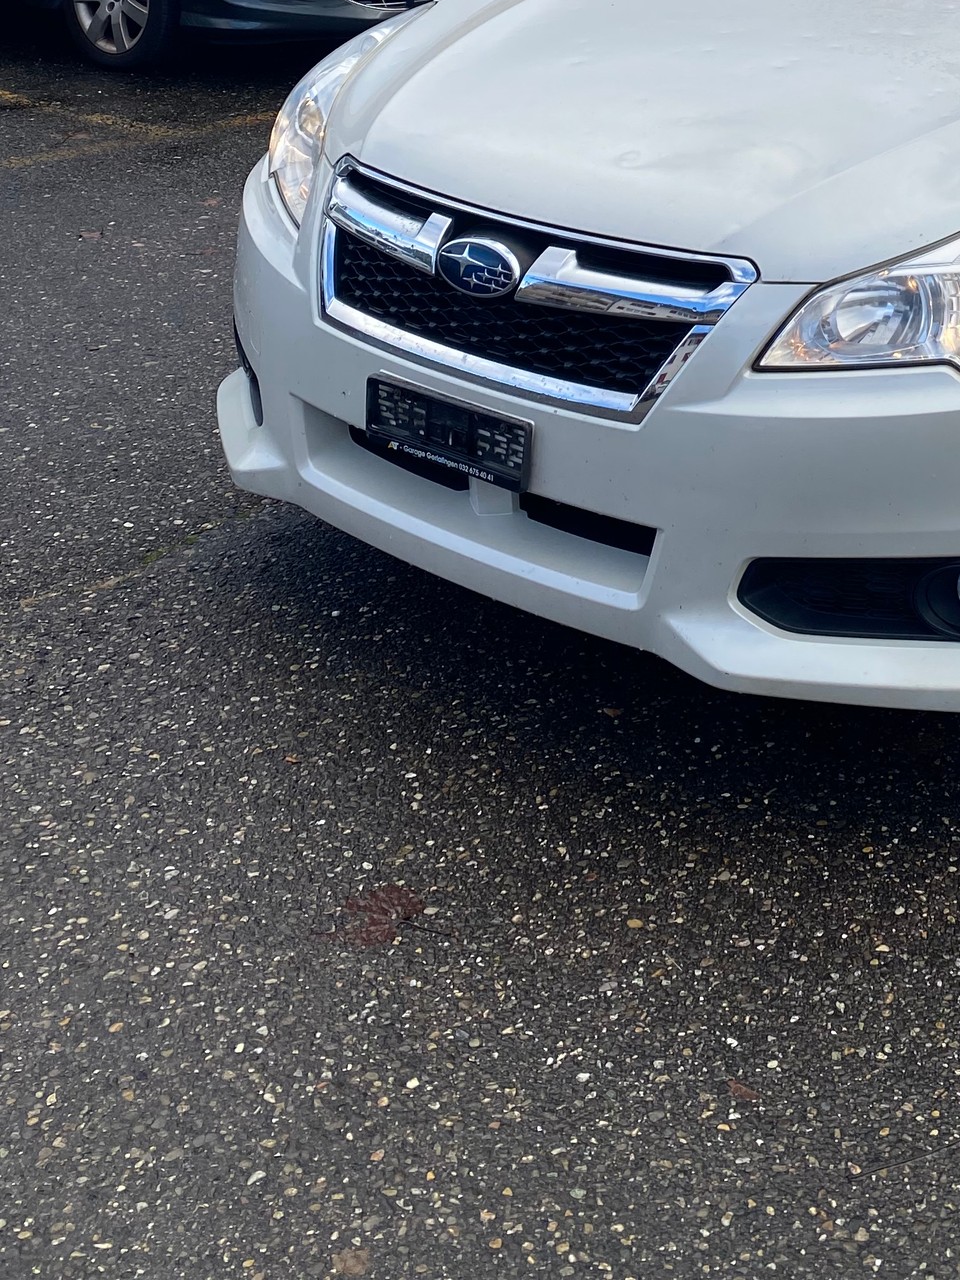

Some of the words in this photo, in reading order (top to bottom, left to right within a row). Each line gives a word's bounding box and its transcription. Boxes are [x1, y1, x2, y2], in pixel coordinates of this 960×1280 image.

[403, 445, 426, 458] Garage
[459, 463, 469, 473] 032
[468, 466, 480, 477] 675
[479, 471, 487, 480] 40
[487, 473, 494, 482] 41
